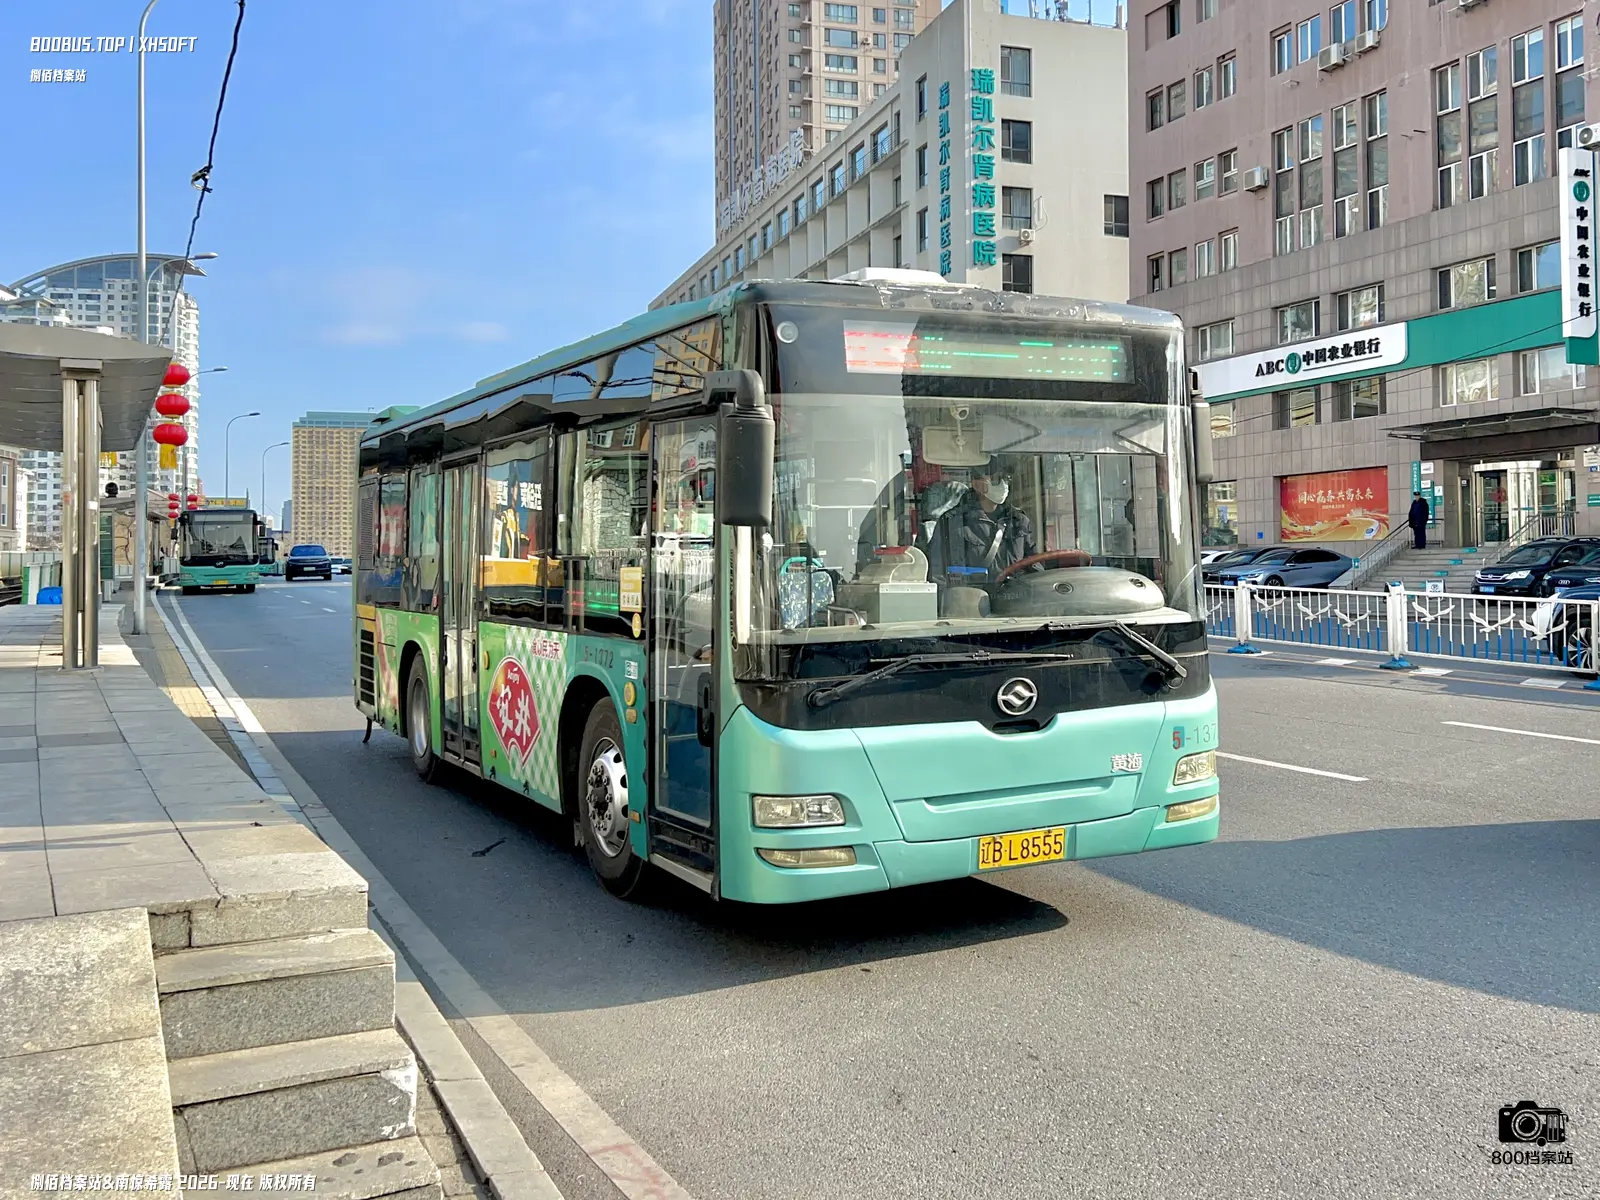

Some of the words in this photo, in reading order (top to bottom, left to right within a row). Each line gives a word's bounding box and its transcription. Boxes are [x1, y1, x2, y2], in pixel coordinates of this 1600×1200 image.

[938, 81, 951, 277] 瑞凯尔肾病医院
[971, 68, 997, 266] 瑞凯尔肾病医院
[1576, 205, 1592, 318] 中国农业银行
[1255, 358, 1285, 378] ABC
[1302, 337, 1381, 366] 中国农业银行
[1110, 752, 1143, 773] 黄海
